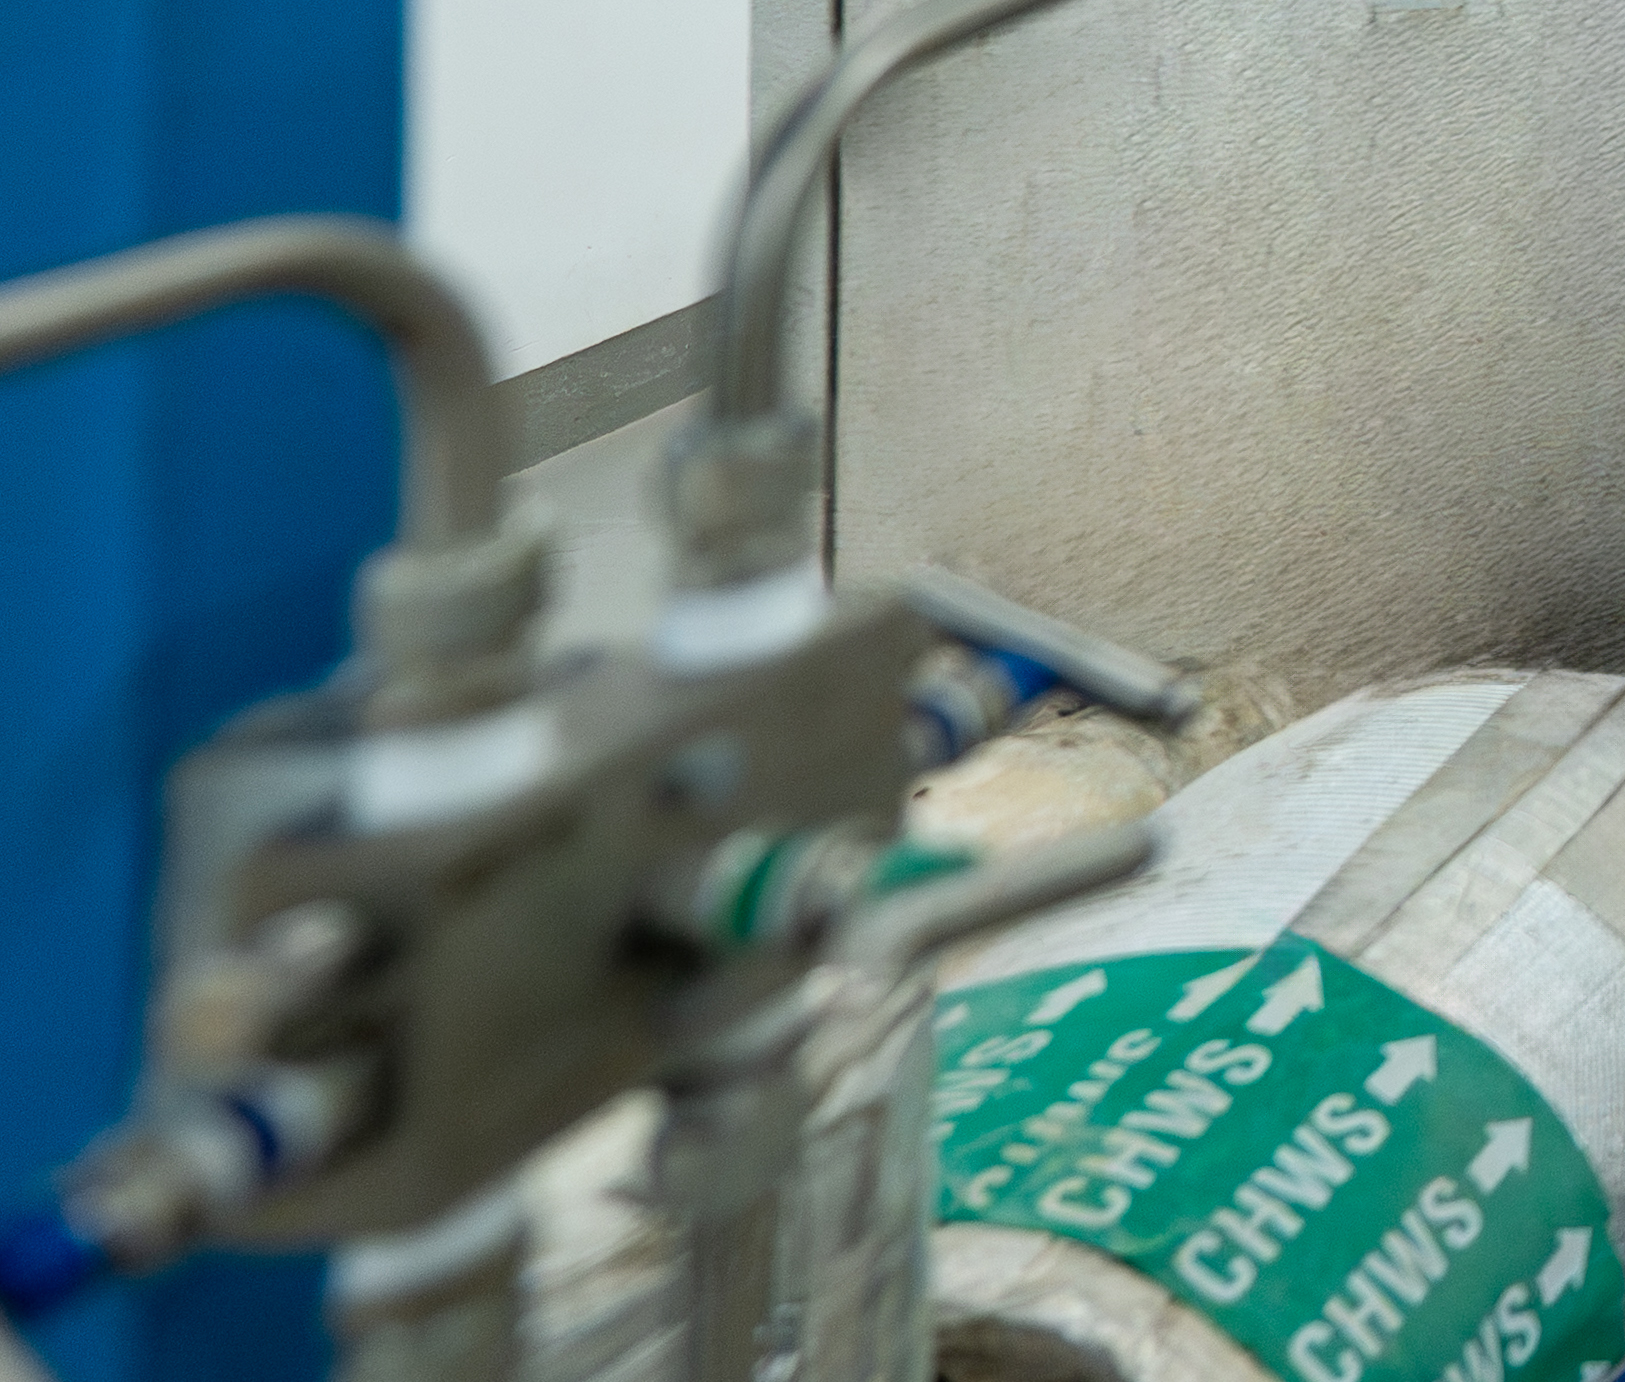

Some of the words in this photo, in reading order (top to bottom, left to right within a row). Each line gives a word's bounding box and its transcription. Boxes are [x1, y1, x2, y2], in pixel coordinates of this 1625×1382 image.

[1037, 1038, 1273, 1226] CHWS
[1172, 1092, 1392, 1303] CHWS
[1287, 1175, 1483, 1382] CHWS
